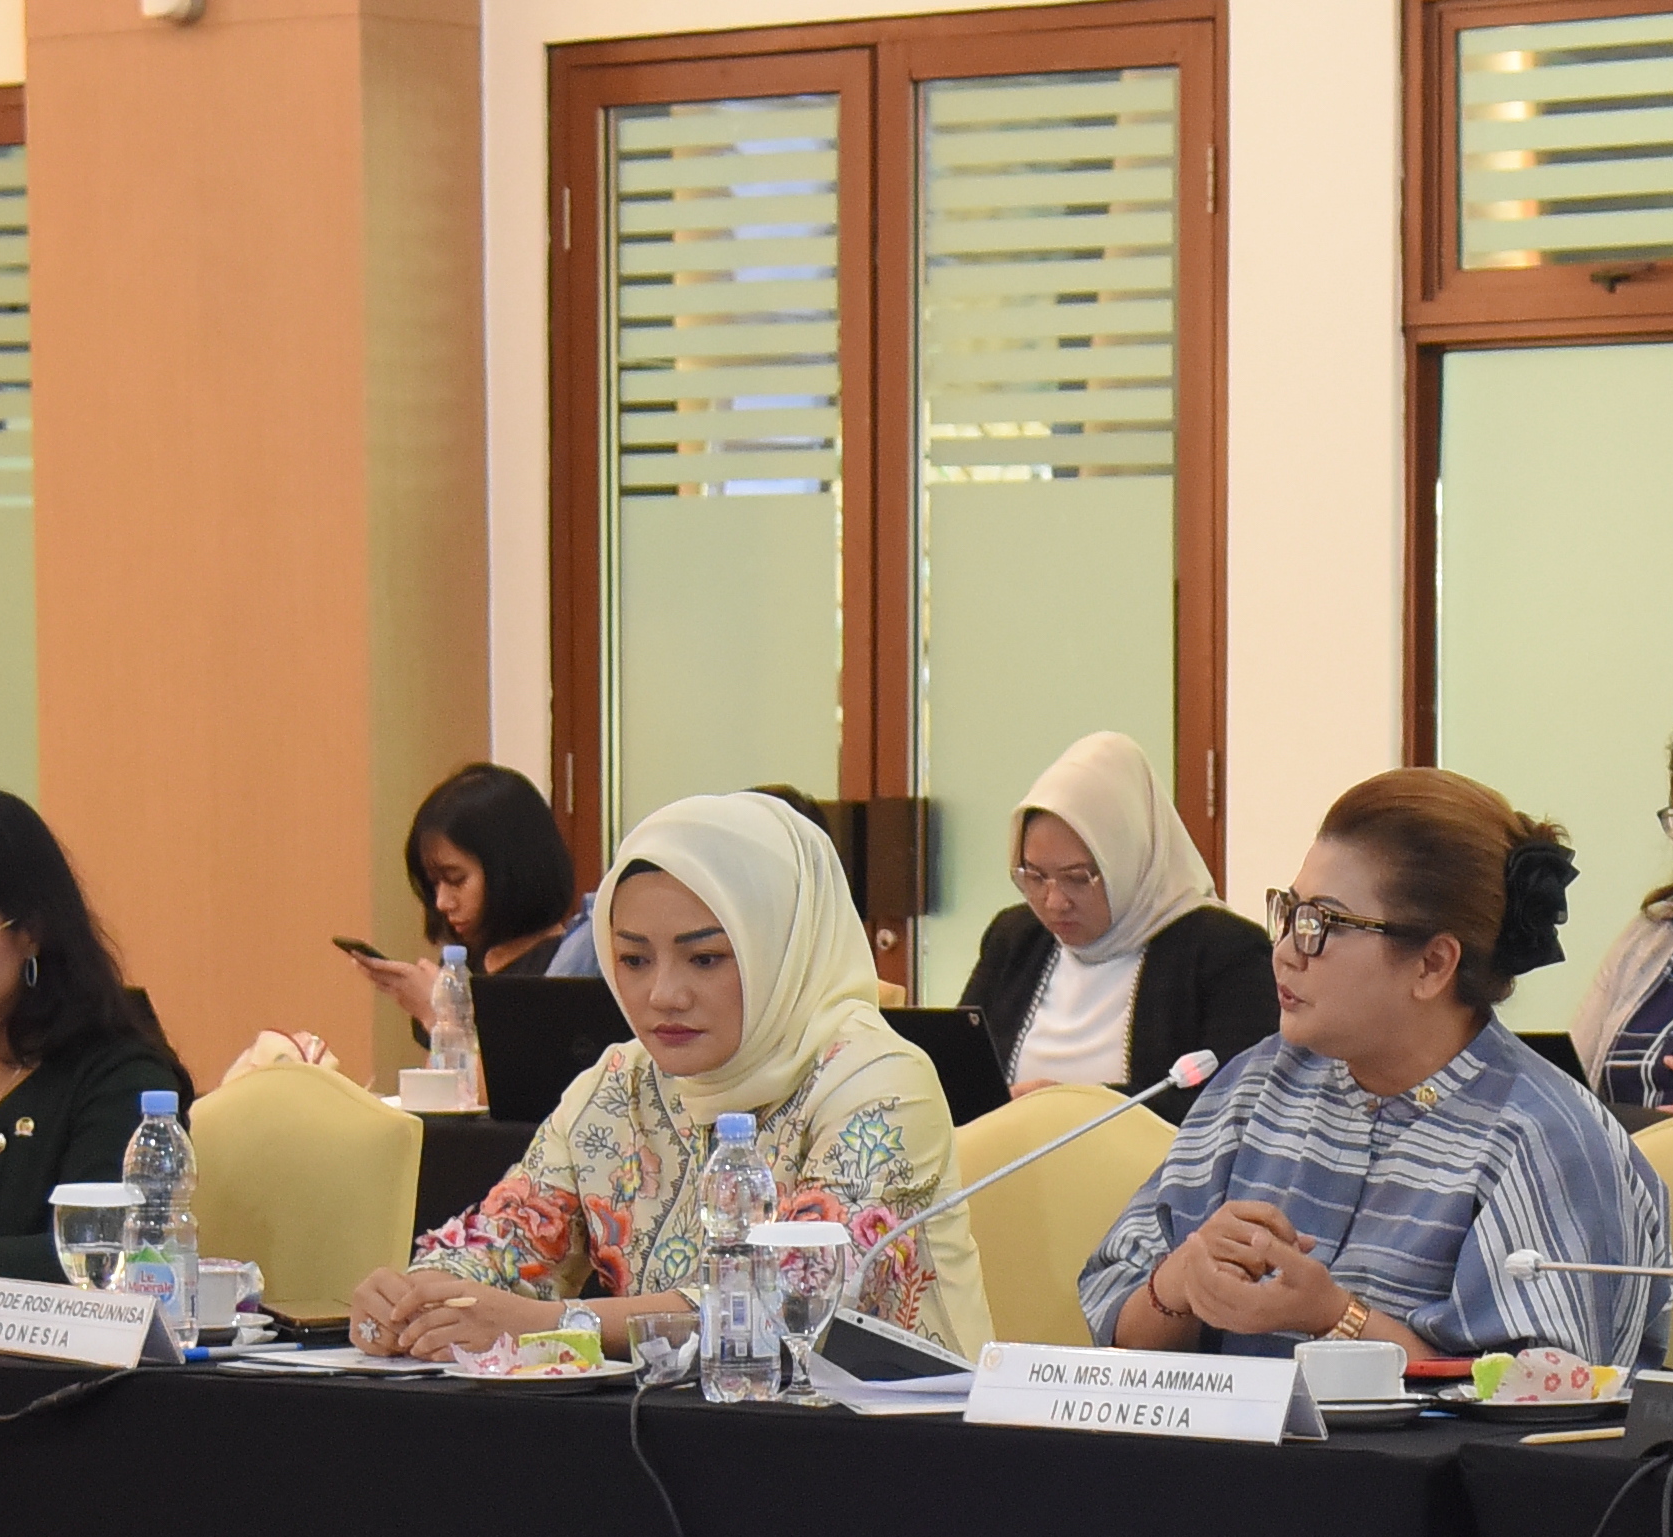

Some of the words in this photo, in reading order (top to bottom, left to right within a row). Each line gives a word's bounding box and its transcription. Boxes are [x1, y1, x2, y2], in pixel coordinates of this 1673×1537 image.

[23, 1297, 54, 1314] ROSI
[55, 1300, 145, 1325] KHOERUNNISA
[1029, 1362, 1069, 1384] HON.
[1073, 1366, 1114, 1387] MRS.
[1118, 1368, 1147, 1388] INA
[1151, 1370, 1235, 1394] AMMANIA
[1050, 1399, 1192, 1429] INDONESIA
